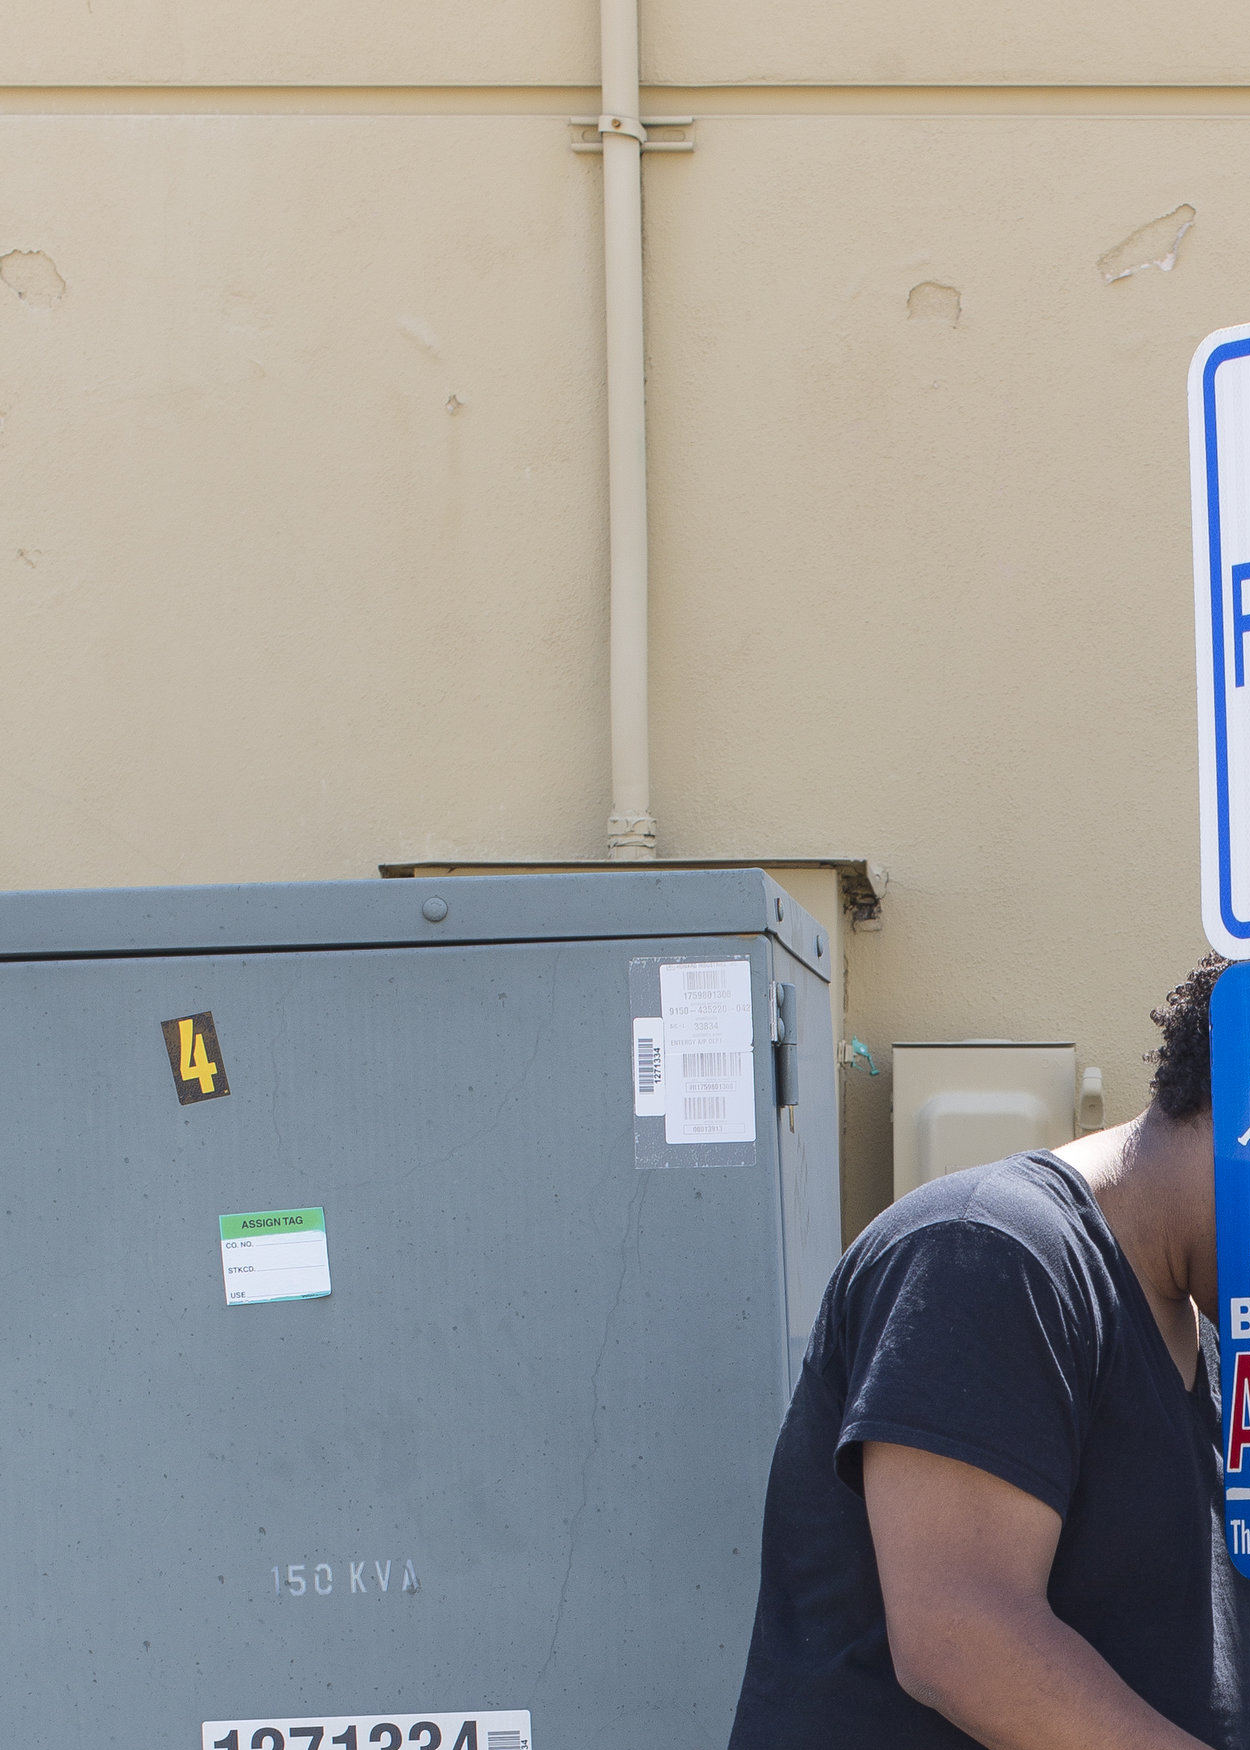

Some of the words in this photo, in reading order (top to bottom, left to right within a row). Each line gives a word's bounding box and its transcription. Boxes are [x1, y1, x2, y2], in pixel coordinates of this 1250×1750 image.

[693, 1022, 719, 1031] 33834
[178, 1018, 218, 1095] 4
[653, 1048, 661, 1084] 1271334
[241, 1218, 281, 1229] ASSIGN
[282, 1216, 303, 1226] TAG
[230, 1291, 246, 1299] USE
[270, 1563, 333, 1597] 150
[350, 1559, 421, 1593] KVA
